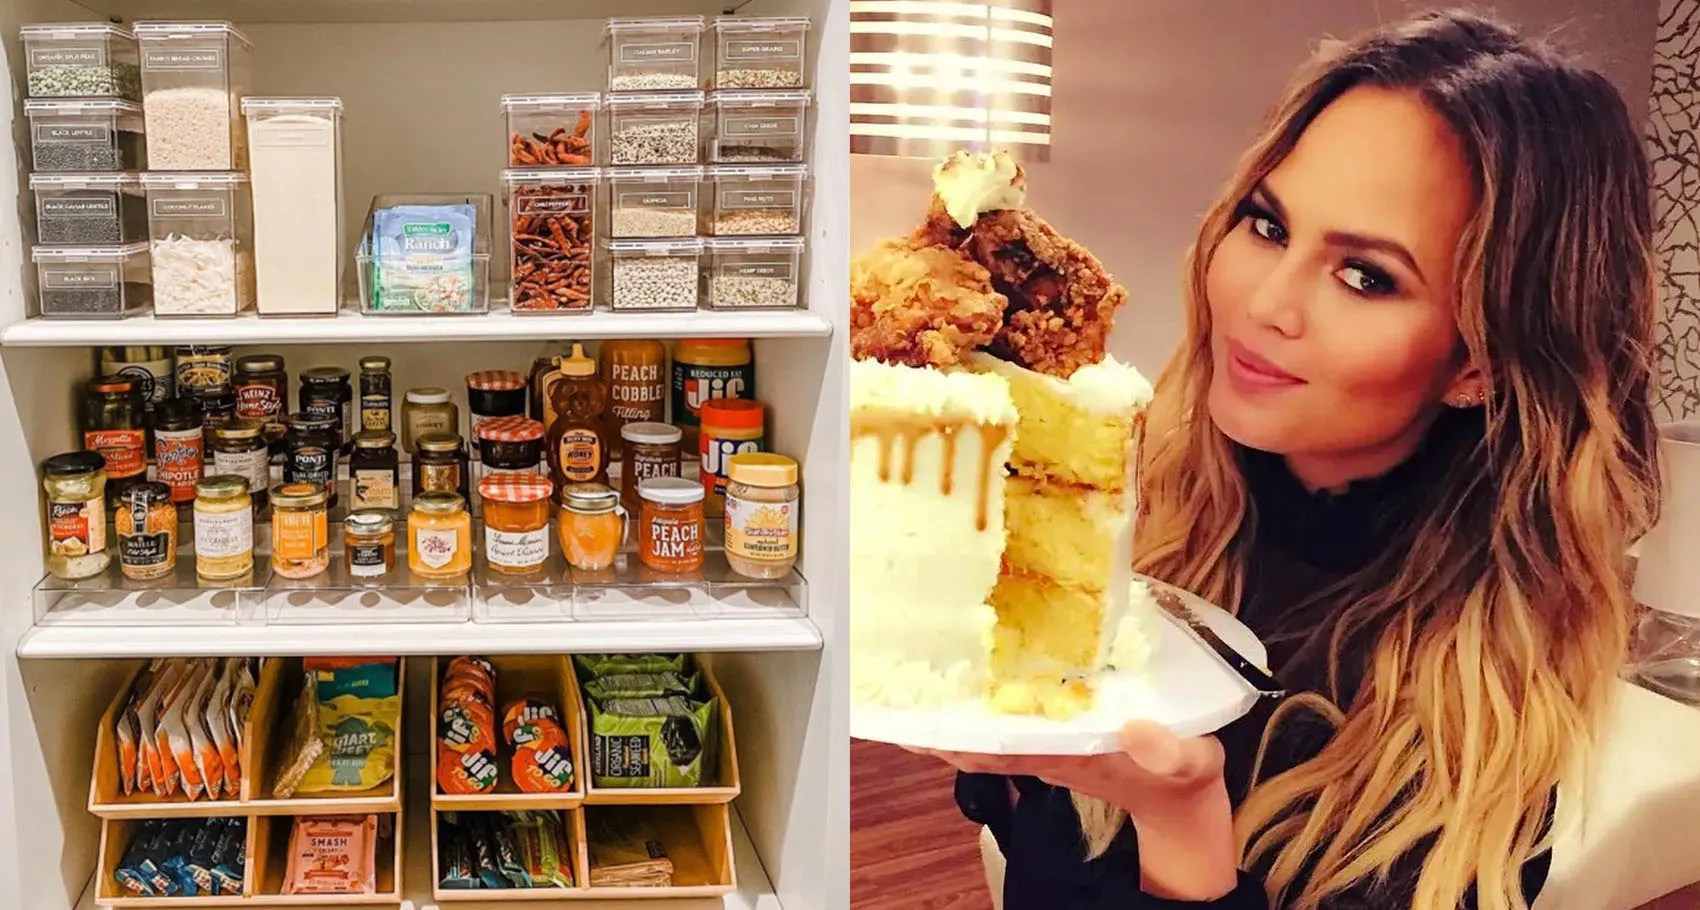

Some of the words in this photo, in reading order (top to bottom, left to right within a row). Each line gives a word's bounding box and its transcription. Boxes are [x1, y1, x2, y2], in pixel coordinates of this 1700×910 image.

[405, 237, 450, 249] Ranch
[612, 364, 657, 381] PEACH
[691, 369, 729, 378] REDUCED
[730, 369, 743, 378] FAT
[243, 389, 271, 399] HEINZ
[687, 378, 745, 410] Jif
[612, 405, 651, 420] Filling
[294, 454, 327, 464] PONTI
[567, 450, 593, 459] HONEY
[634, 462, 677, 478] PEACH
[652, 523, 698, 541] PEACH
[652, 541, 685, 558] JAM
[534, 748, 573, 777] Jif
[610, 737, 623, 776] ORGANIC
[629, 736, 642, 776] SEAWEED
[460, 751, 498, 781] Jif
[451, 766, 468, 779] TO
[468, 777, 484, 790] GO
[526, 764, 543, 777] TO
[543, 773, 561, 788] GO
[311, 838, 348, 846] SMASH
